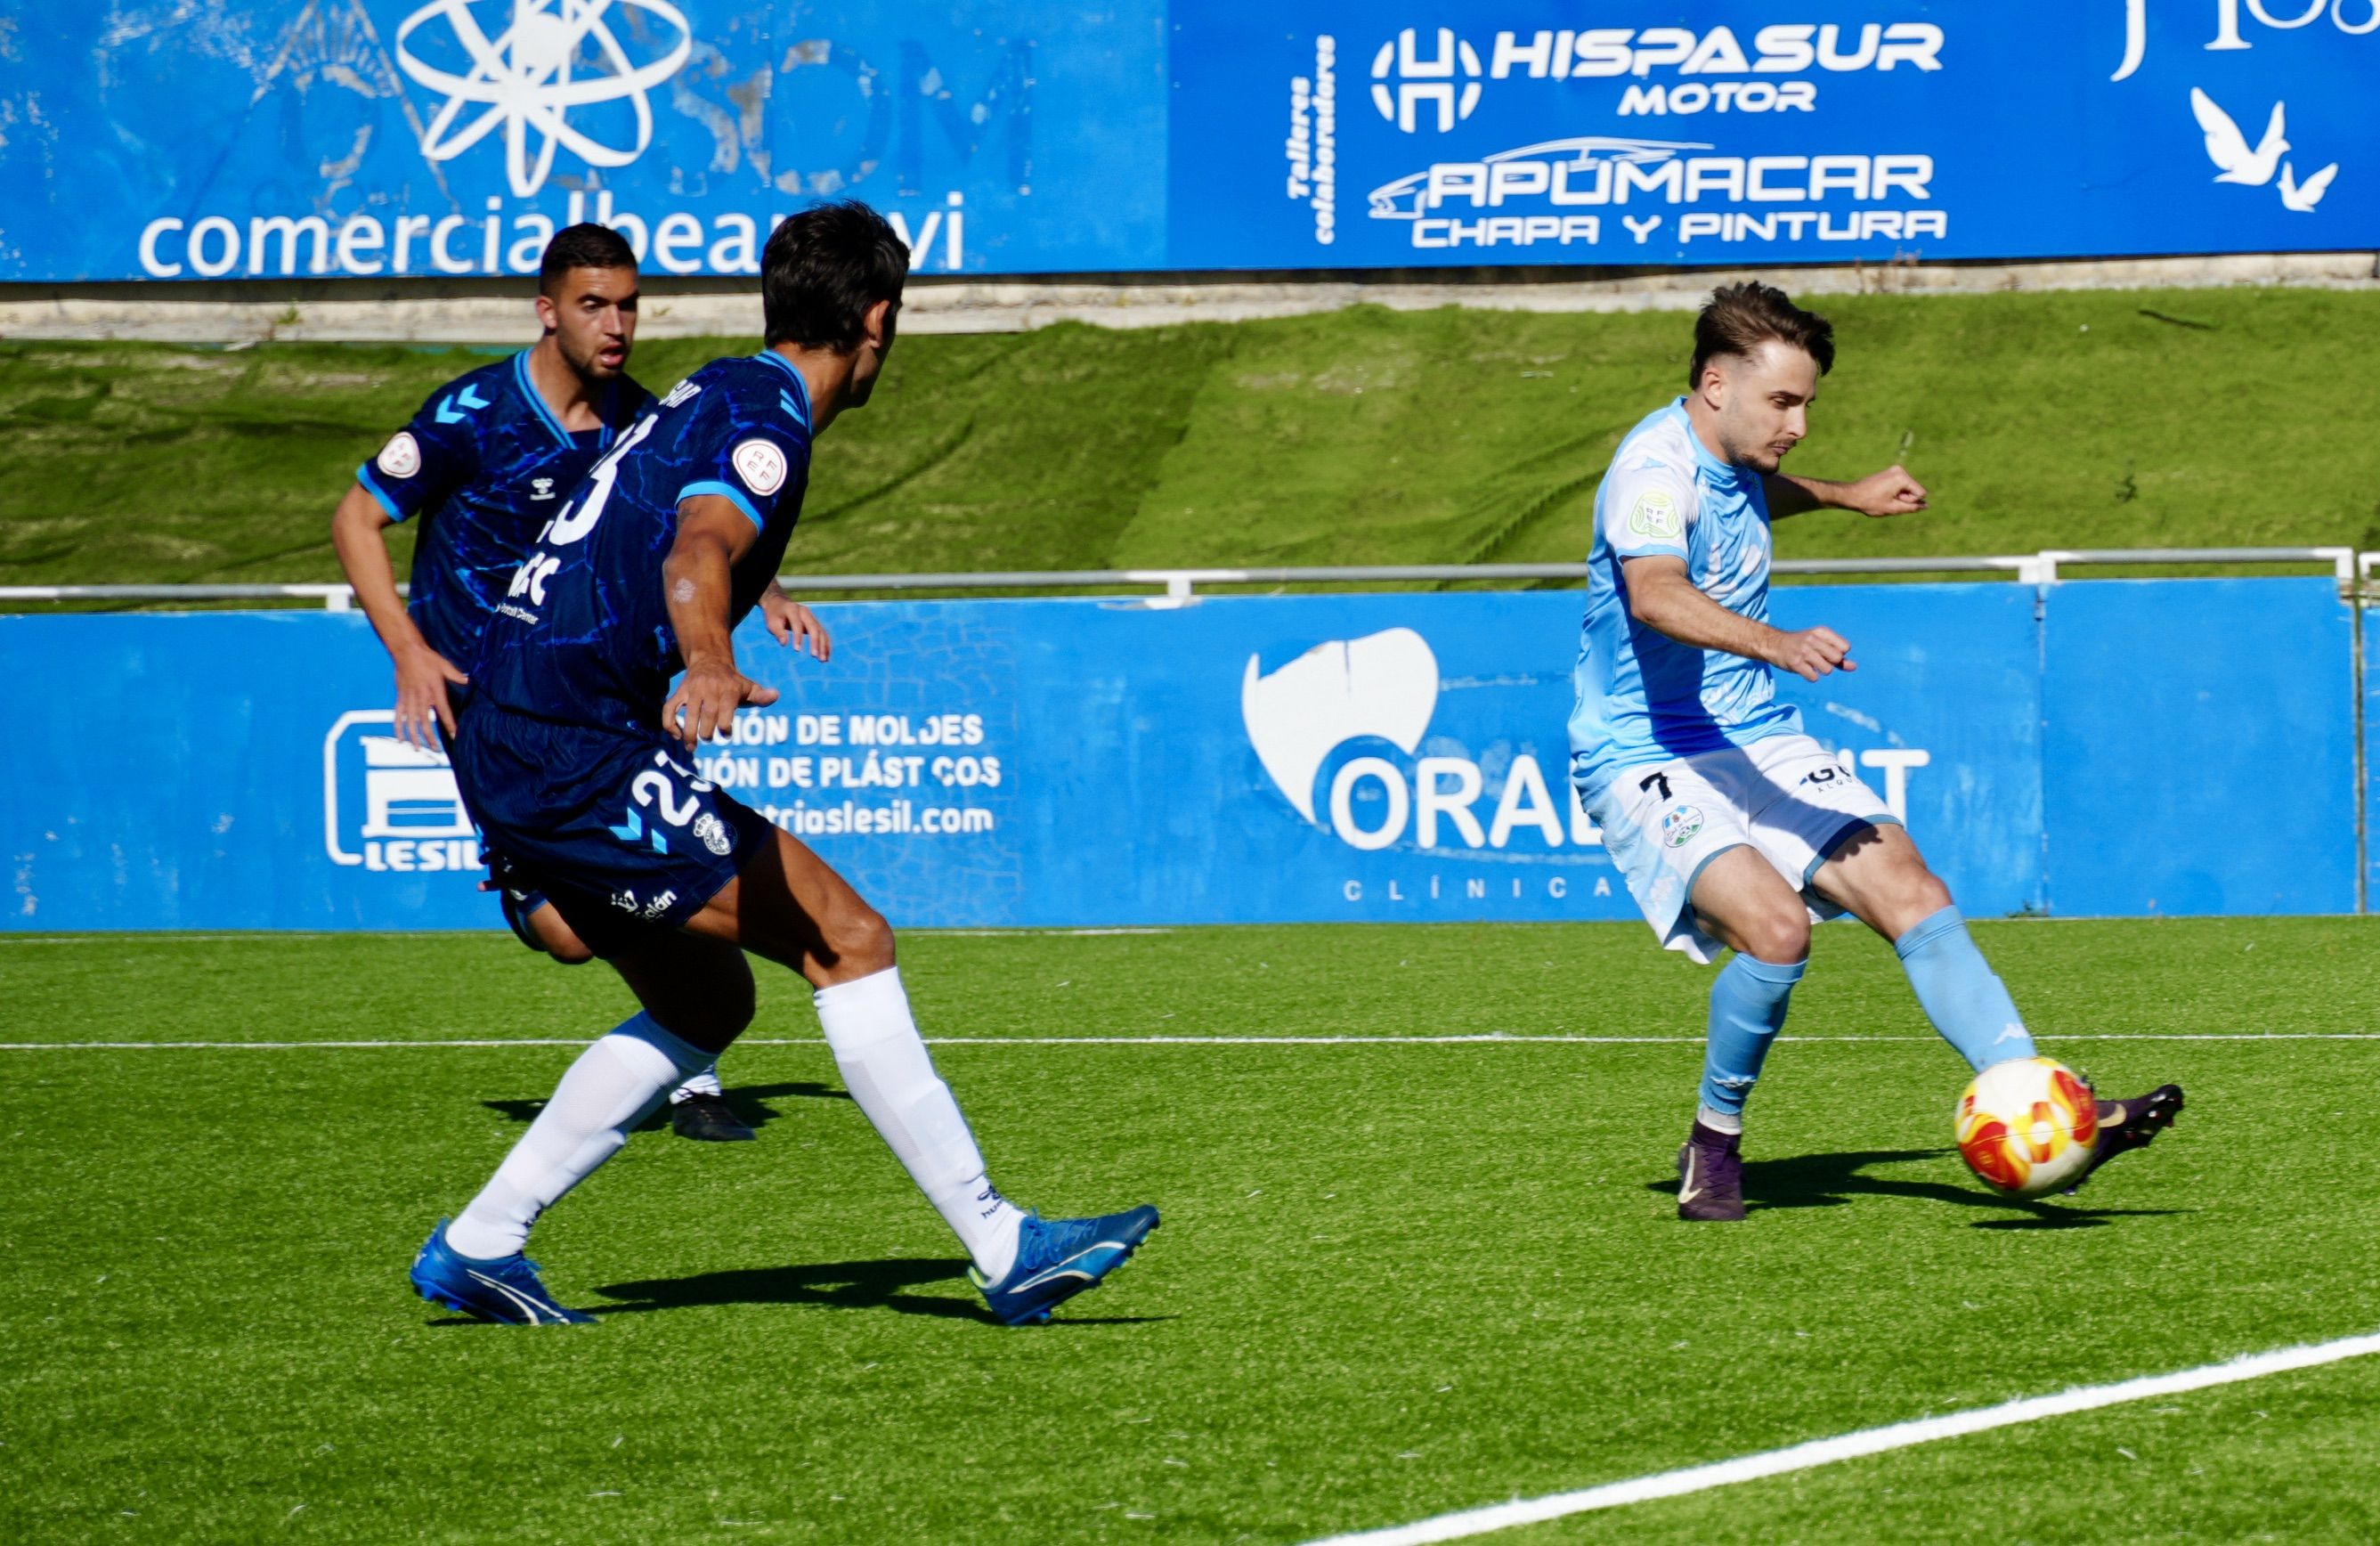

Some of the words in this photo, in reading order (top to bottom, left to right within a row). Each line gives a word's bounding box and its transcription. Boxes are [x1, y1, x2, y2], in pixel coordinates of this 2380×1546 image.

[1491, 23, 1944, 79] HISPASUR
[1617, 81, 1817, 116] MOTOR
[1286, 77, 1311, 199] Talleres
[1311, 34, 1335, 245] colaboradores
[1426, 153, 1934, 208] APUMACAR
[1412, 216, 1600, 248] CHAPA
[1622, 215, 1662, 245] Y
[1678, 209, 1948, 244] PINTURA
[796, 714, 842, 746] DE
[692, 748, 761, 789] IÓN
[768, 756, 814, 789] DE
[819, 748, 1002, 789] PLÁSTCOS
[1639, 771, 1673, 802] 7
[365, 840, 484, 872] LESIL
[1344, 874, 1612, 901] CLÍNICA
